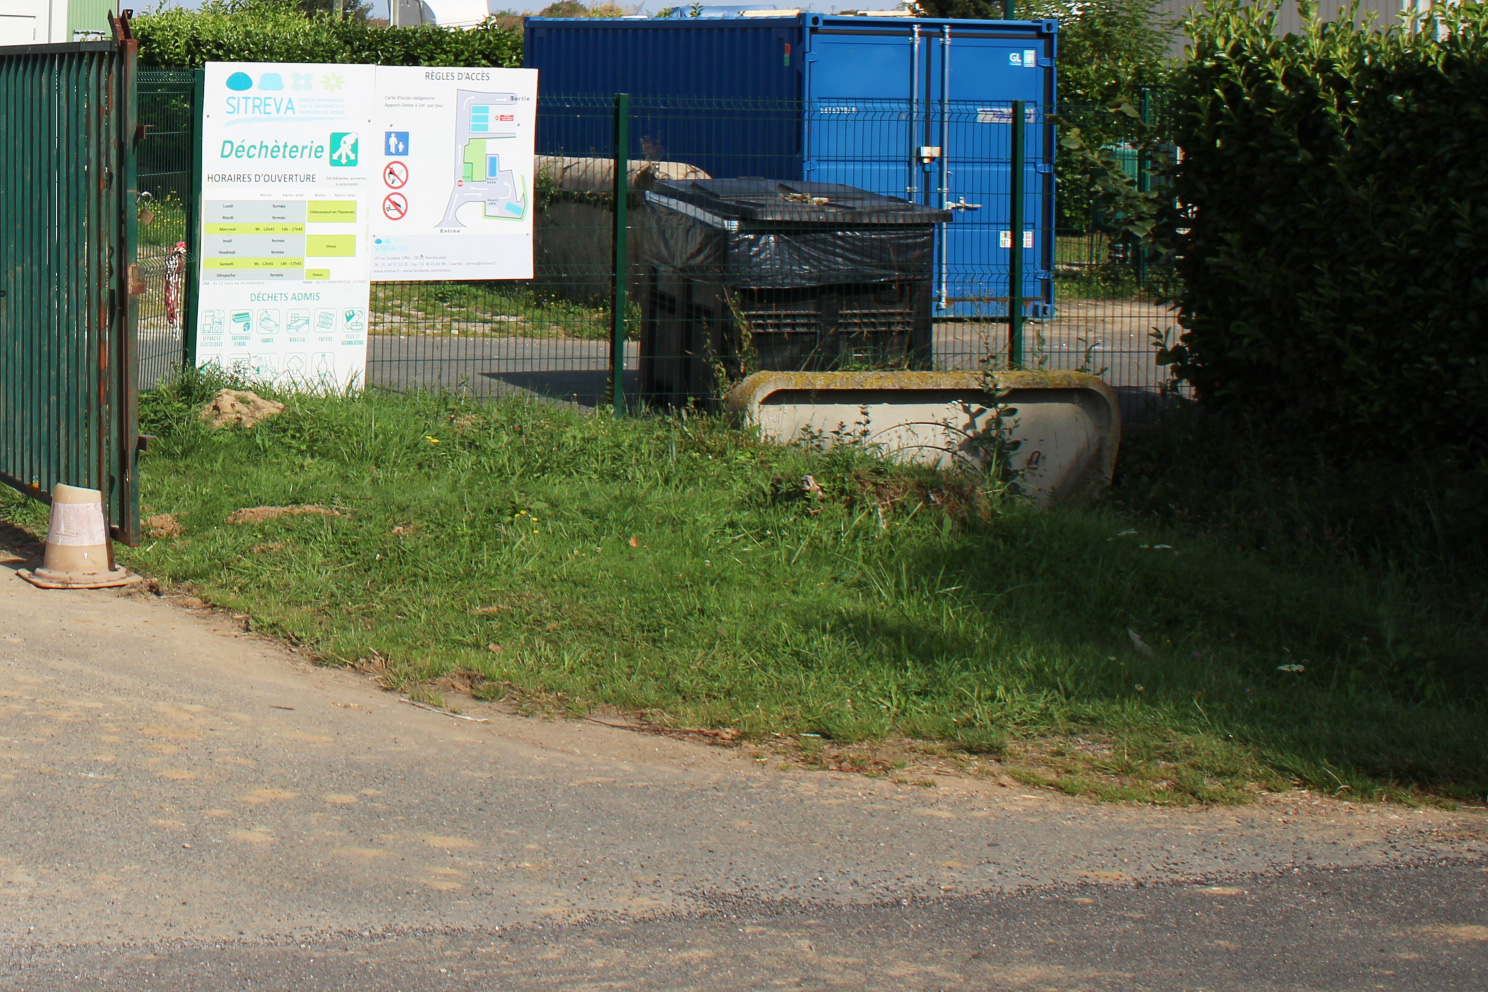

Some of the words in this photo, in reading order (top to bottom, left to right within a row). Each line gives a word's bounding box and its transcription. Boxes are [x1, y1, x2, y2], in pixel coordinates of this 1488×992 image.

[424, 70, 454, 80] RÈGLES
[457, 70, 490, 81] D'ACCÈS
[225, 96, 296, 115] SITREVA
[220, 139, 324, 158] Déchèterie
[207, 174, 252, 182] HORAIRES
[254, 174, 316, 182] D'OUVERTURE
[250, 291, 289, 301] DÉCHETS
[291, 292, 320, 301] ADMIS
